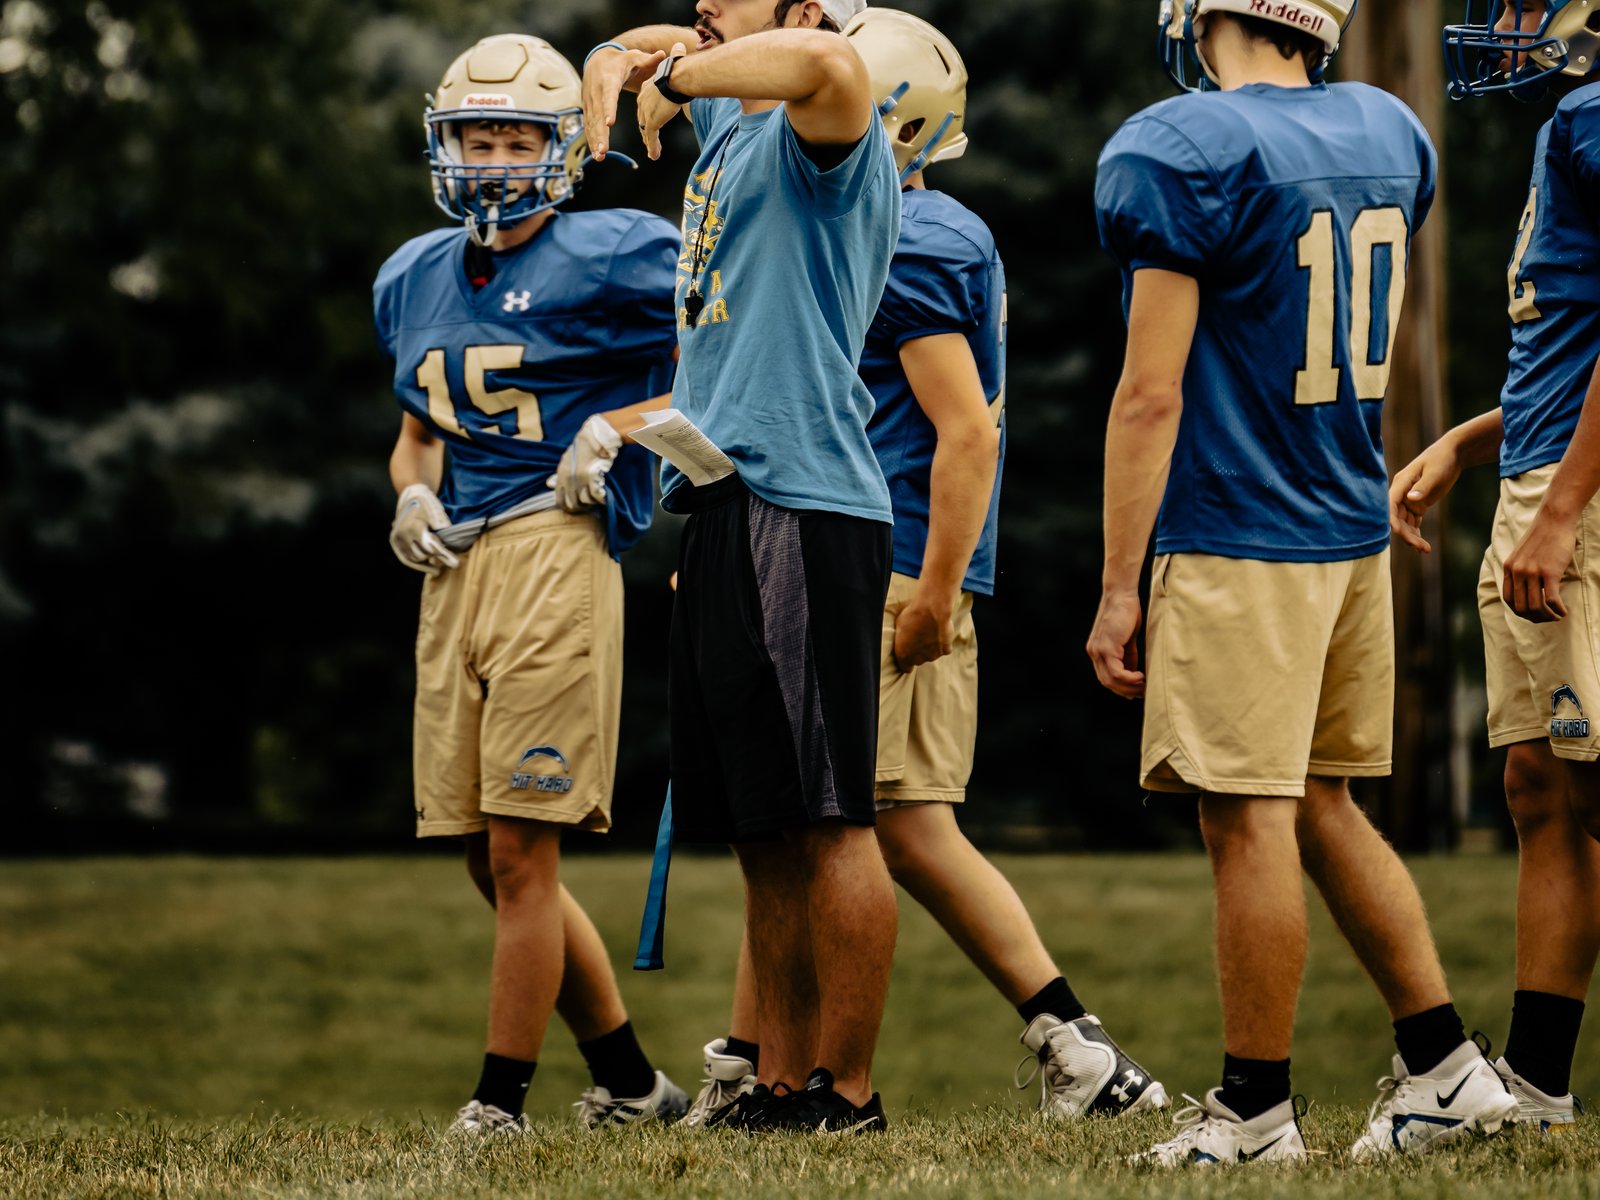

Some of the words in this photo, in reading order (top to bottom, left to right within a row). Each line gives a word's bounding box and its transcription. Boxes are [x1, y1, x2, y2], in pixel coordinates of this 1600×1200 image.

[466, 96, 508, 106] Riddell
[1294, 206, 1408, 405] 10
[416, 343, 545, 443] 15
[1563, 717, 1590, 738] HARD
[510, 771, 533, 790] HIT
[535, 774, 574, 794] HARD
